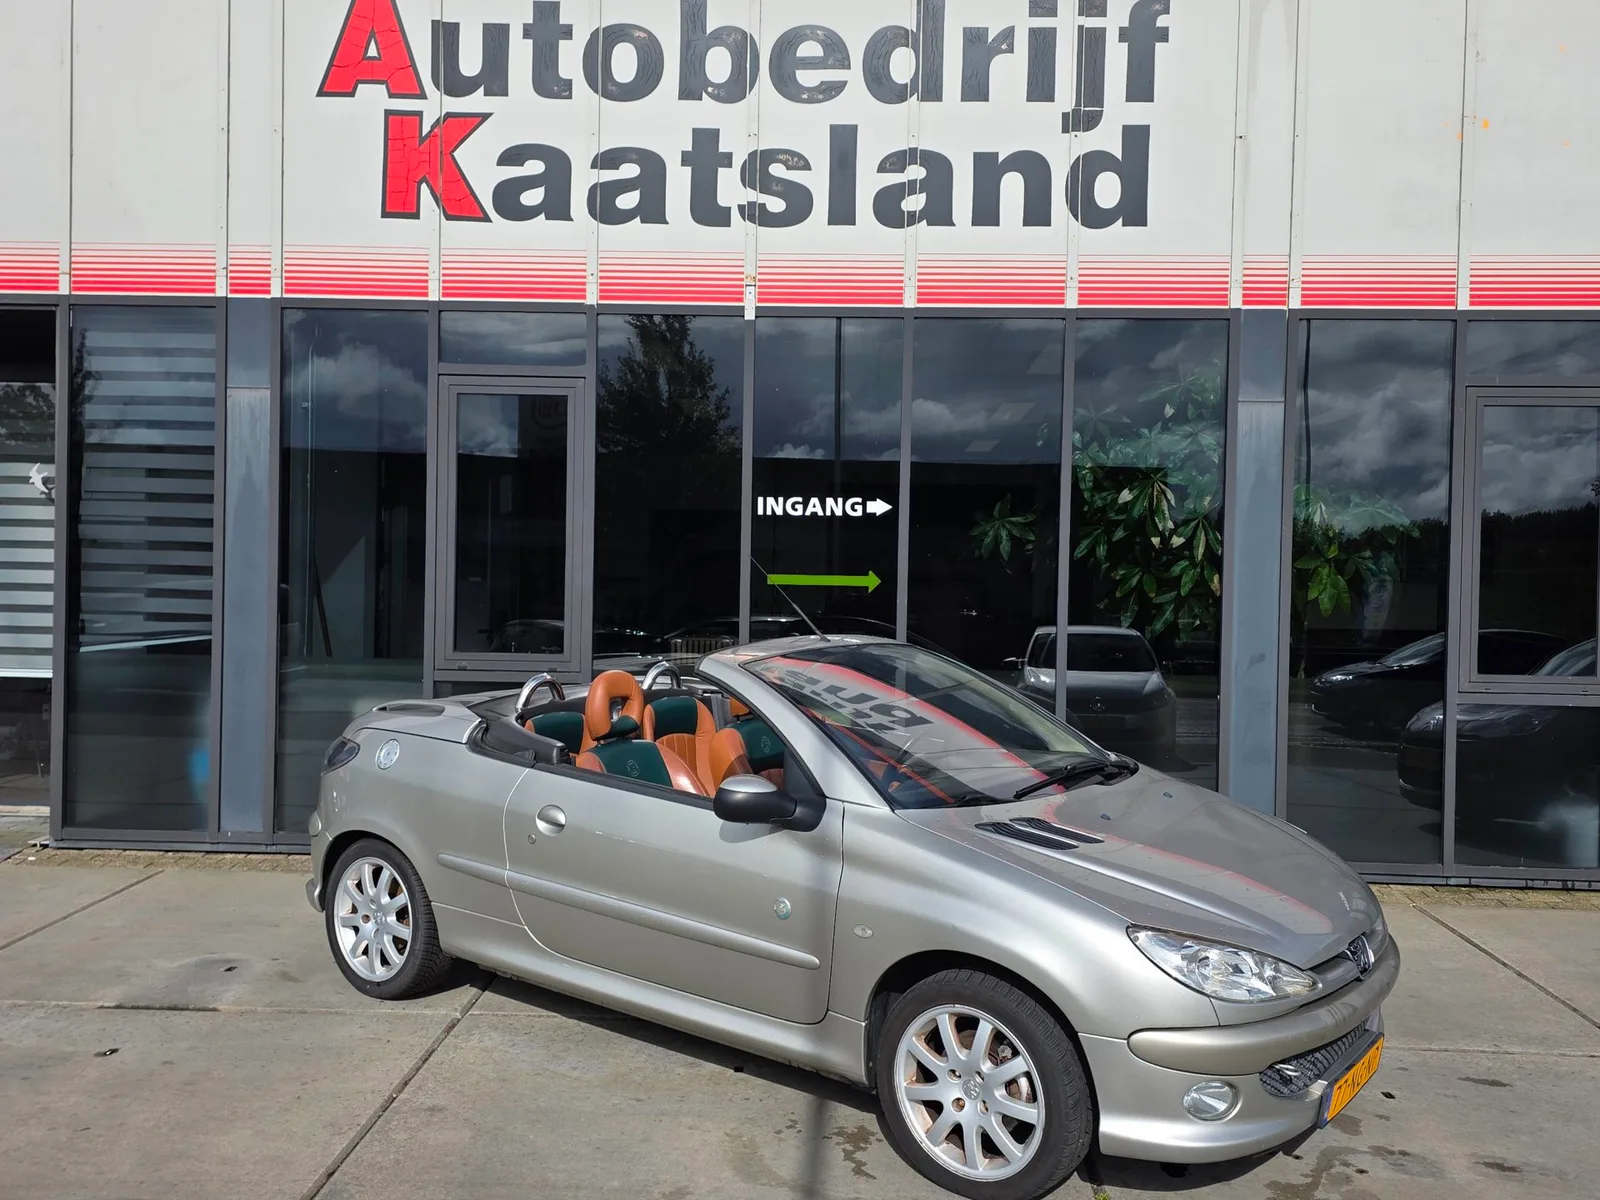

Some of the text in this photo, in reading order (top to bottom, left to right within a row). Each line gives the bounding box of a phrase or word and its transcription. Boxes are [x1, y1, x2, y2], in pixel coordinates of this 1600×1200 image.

[315, 0, 1171, 134] Autobedrijf
[381, 108, 1151, 229] Kaatsland
[757, 496, 863, 516] INGANG
